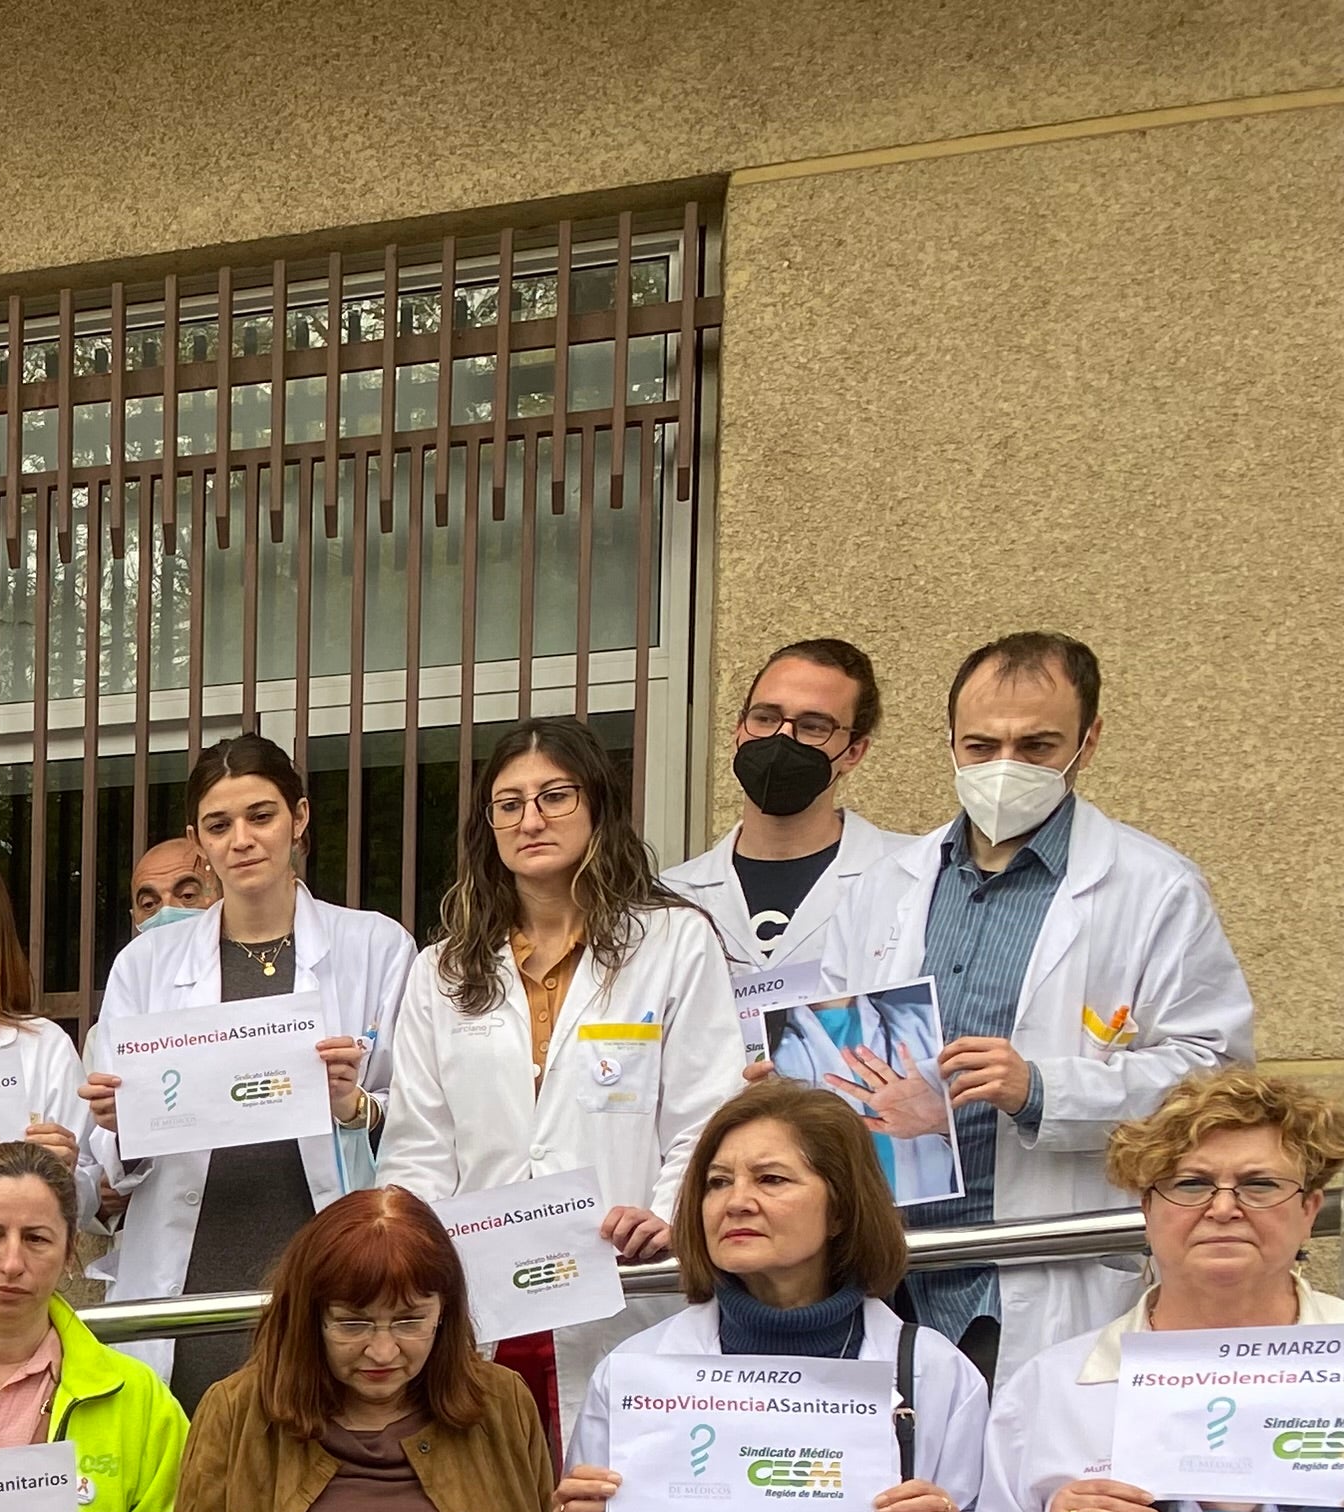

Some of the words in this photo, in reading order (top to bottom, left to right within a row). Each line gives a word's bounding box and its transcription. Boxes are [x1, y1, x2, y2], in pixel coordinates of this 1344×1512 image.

[734, 978, 784, 999] MARZO
[739, 1007, 760, 1020] cia
[116, 1018, 315, 1056] #StopViolenciaASanitarios
[447, 1196, 595, 1239] olenciaASanitarios
[1219, 1344, 1230, 1357] 9
[1236, 1343, 1261, 1357] DE
[1267, 1340, 1341, 1356] MARZO
[696, 1370, 706, 1383] 9
[711, 1370, 734, 1384] DE
[738, 1370, 802, 1385] MARZO
[1131, 1370, 1344, 1388] #StopViolenciaASa
[621, 1395, 877, 1416] #StopViolenciaASanitarios
[1263, 1418, 1330, 1428] Sindicato
[739, 1446, 795, 1458] Sindicato
[799, 1447, 843, 1459] Médico
[1273, 1431, 1344, 1460] CES
[747, 1459, 843, 1487] CESM
[1292, 1462, 1328, 1472] Región
[765, 1489, 797, 1499] Región
[798, 1490, 810, 1498] de
[812, 1490, 844, 1499] Murcia
